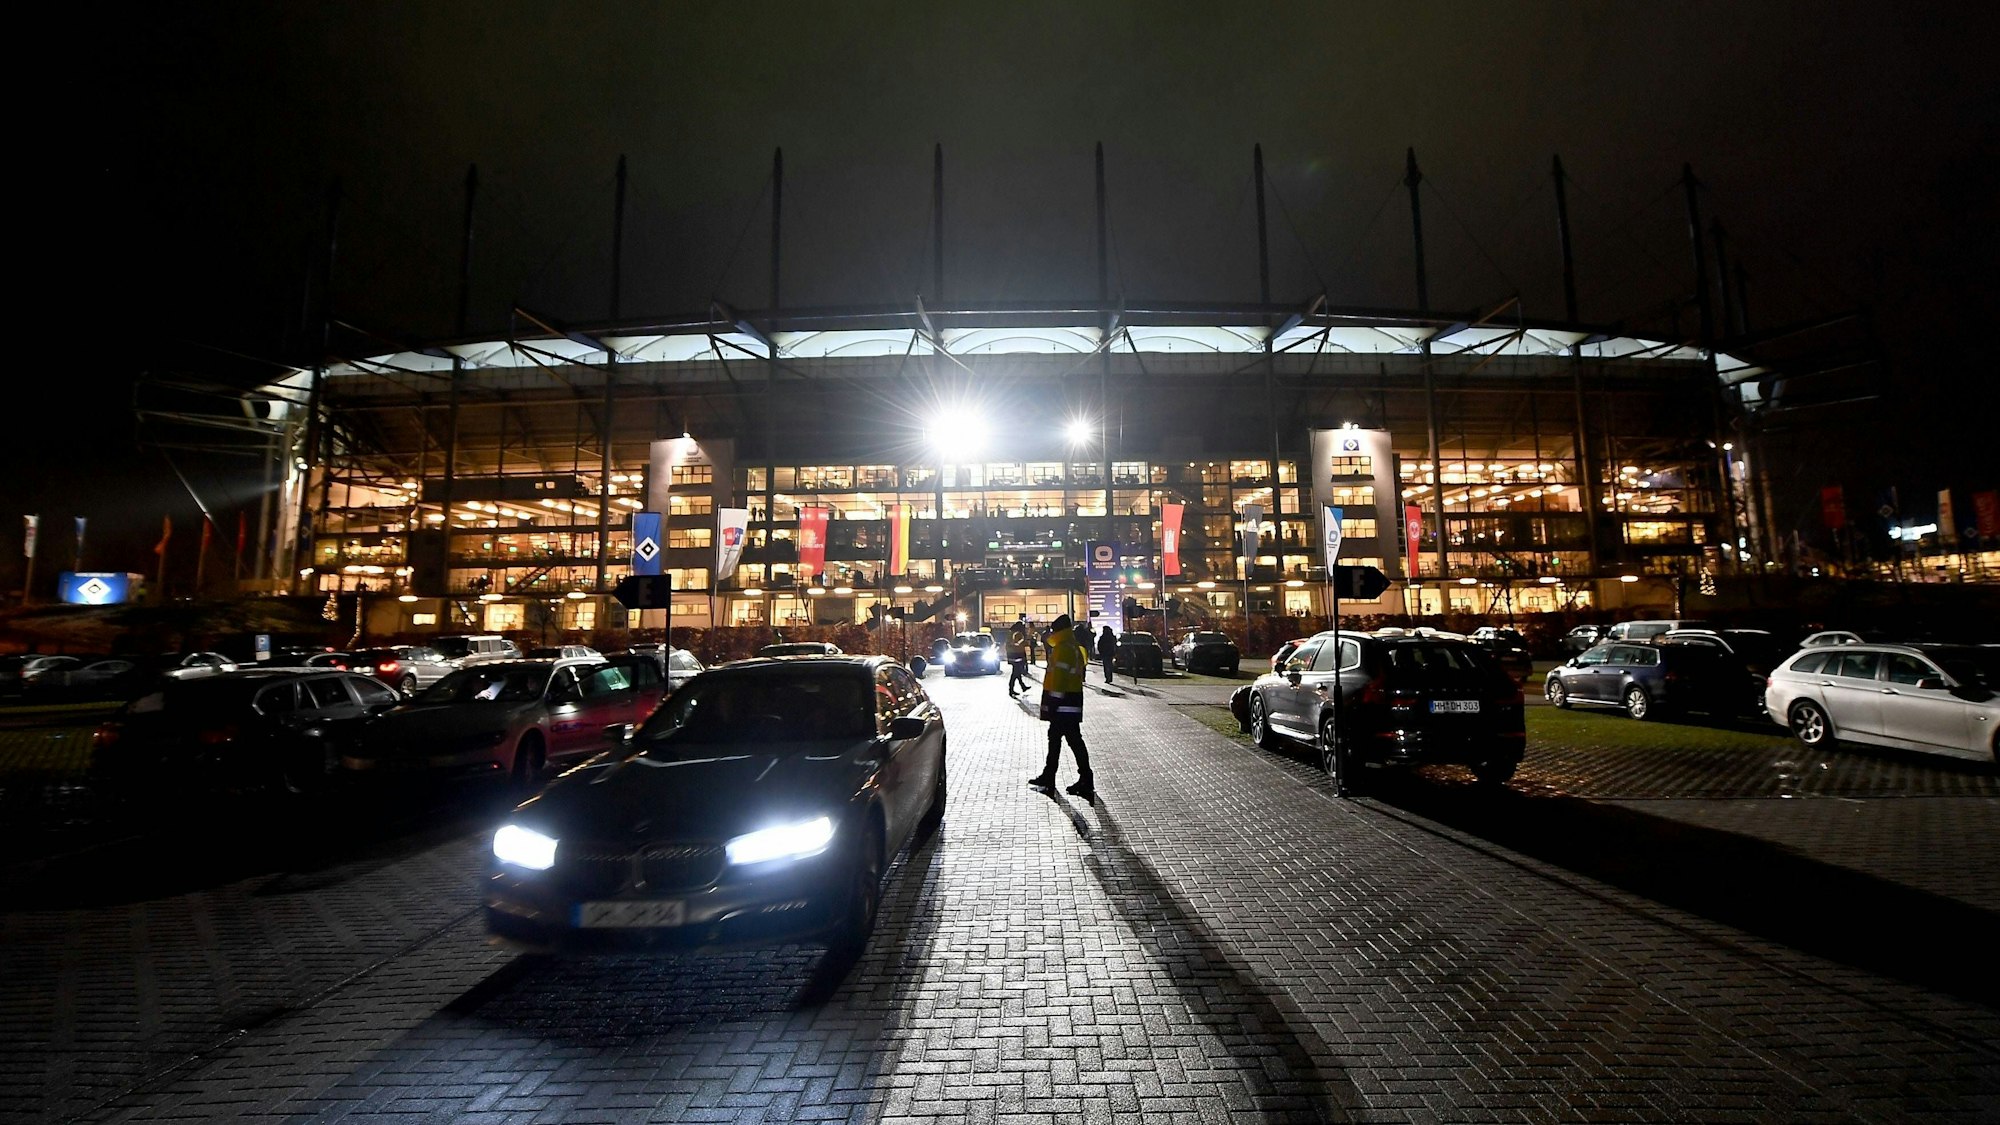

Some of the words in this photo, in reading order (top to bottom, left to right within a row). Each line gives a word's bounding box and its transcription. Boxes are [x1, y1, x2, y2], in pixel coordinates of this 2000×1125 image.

[639, 578, 653, 607] E
[1352, 568, 1365, 597] F
[1434, 701, 1446, 711] HH
